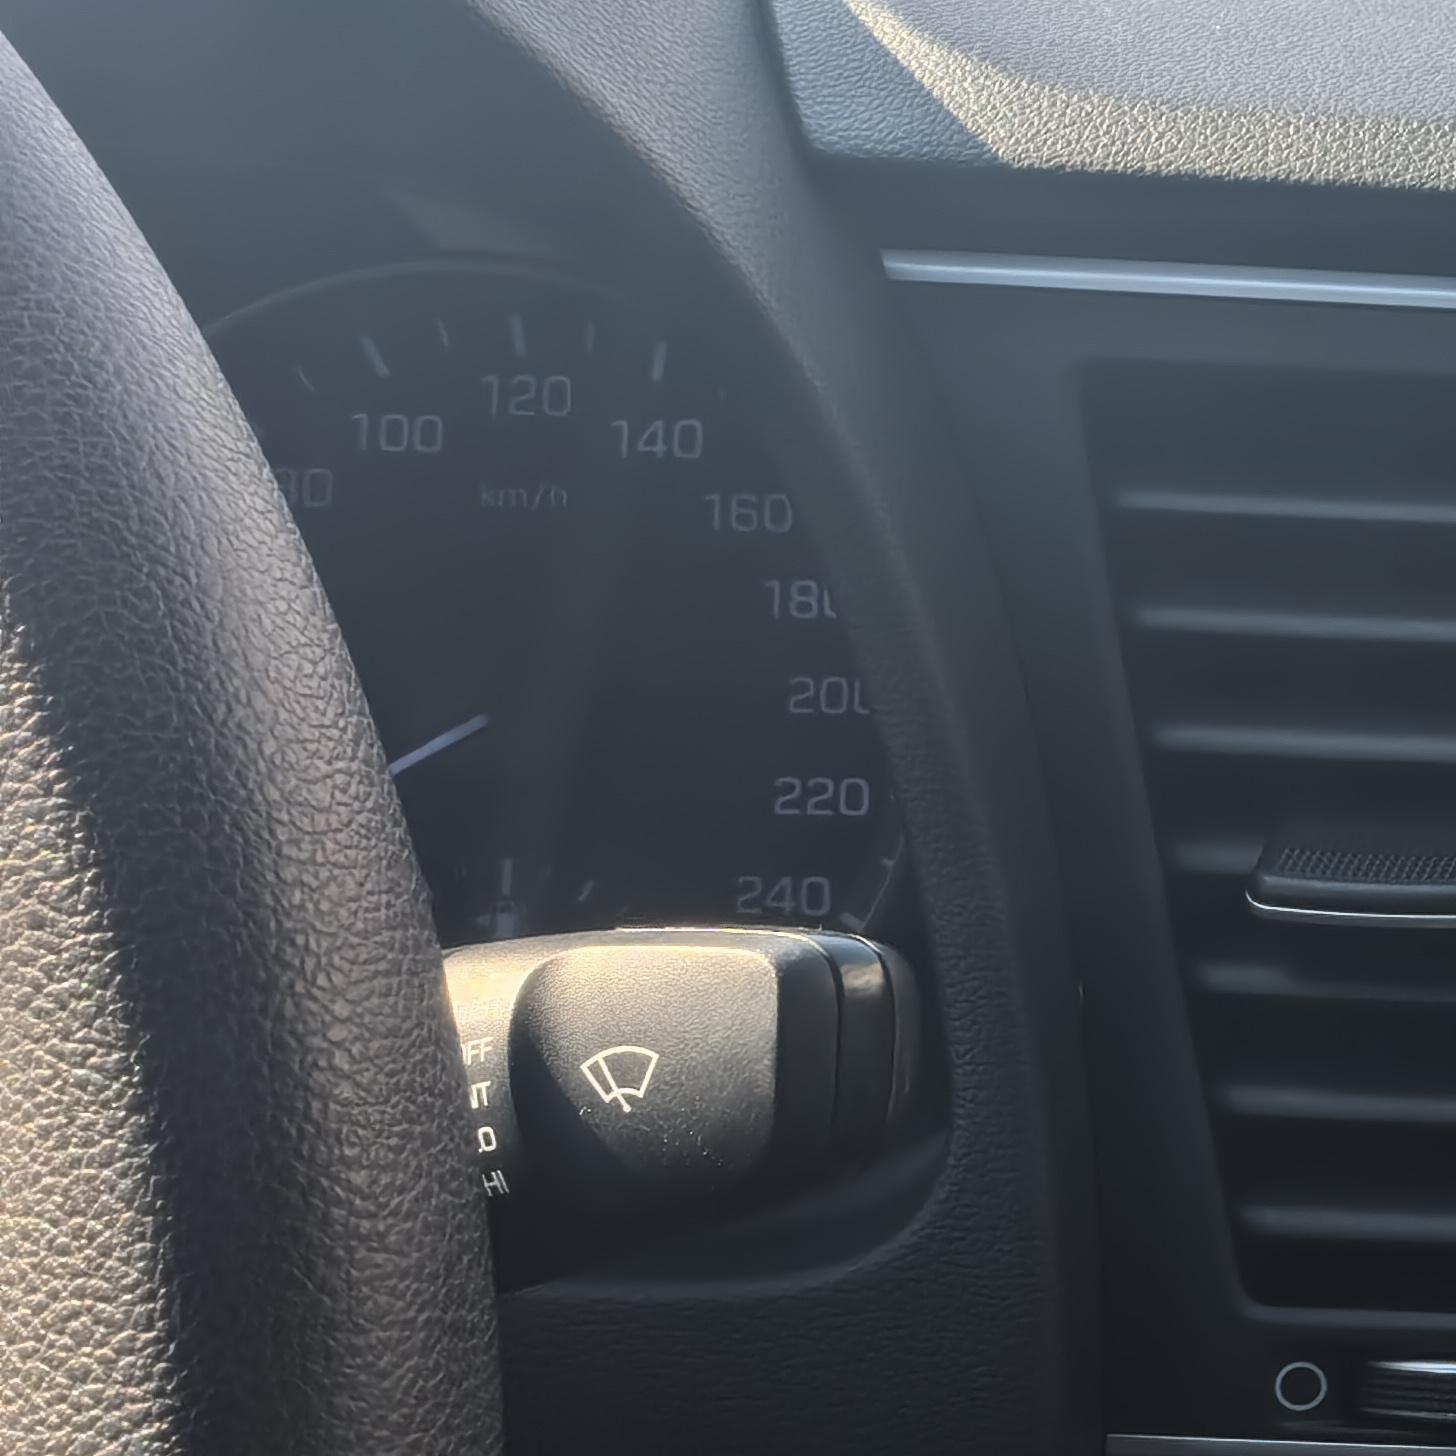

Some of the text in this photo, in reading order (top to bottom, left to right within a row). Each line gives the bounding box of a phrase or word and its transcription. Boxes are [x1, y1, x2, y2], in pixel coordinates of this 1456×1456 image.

[479, 373, 573, 418] 120
[350, 411, 444, 454] 100
[610, 417, 704, 460] 140
[479, 483, 569, 510] km/h
[703, 491, 794, 534] 160
[773, 775, 871, 817] 220
[734, 874, 832, 918] 240
[461, 1036, 494, 1065] FF
